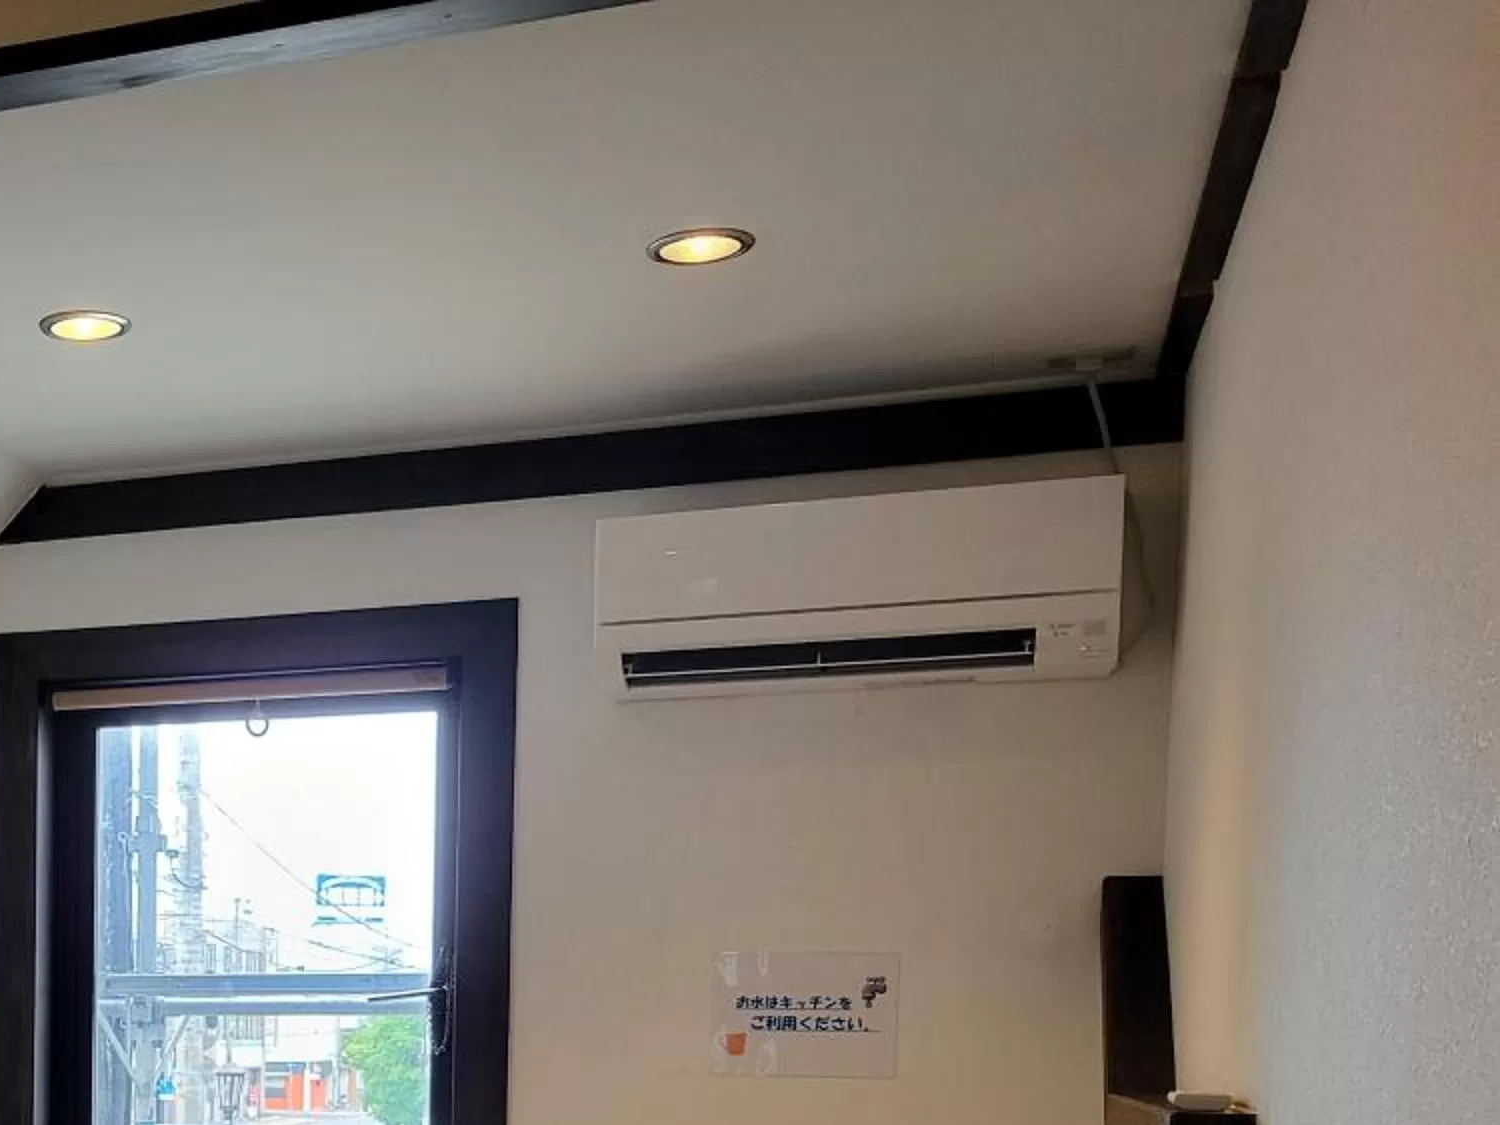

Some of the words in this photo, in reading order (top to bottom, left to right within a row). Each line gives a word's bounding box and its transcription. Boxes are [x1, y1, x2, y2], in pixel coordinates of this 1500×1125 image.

[736, 995, 852, 1010] お水はキッチンを
[750, 1015, 869, 1032] ご利用ください。
